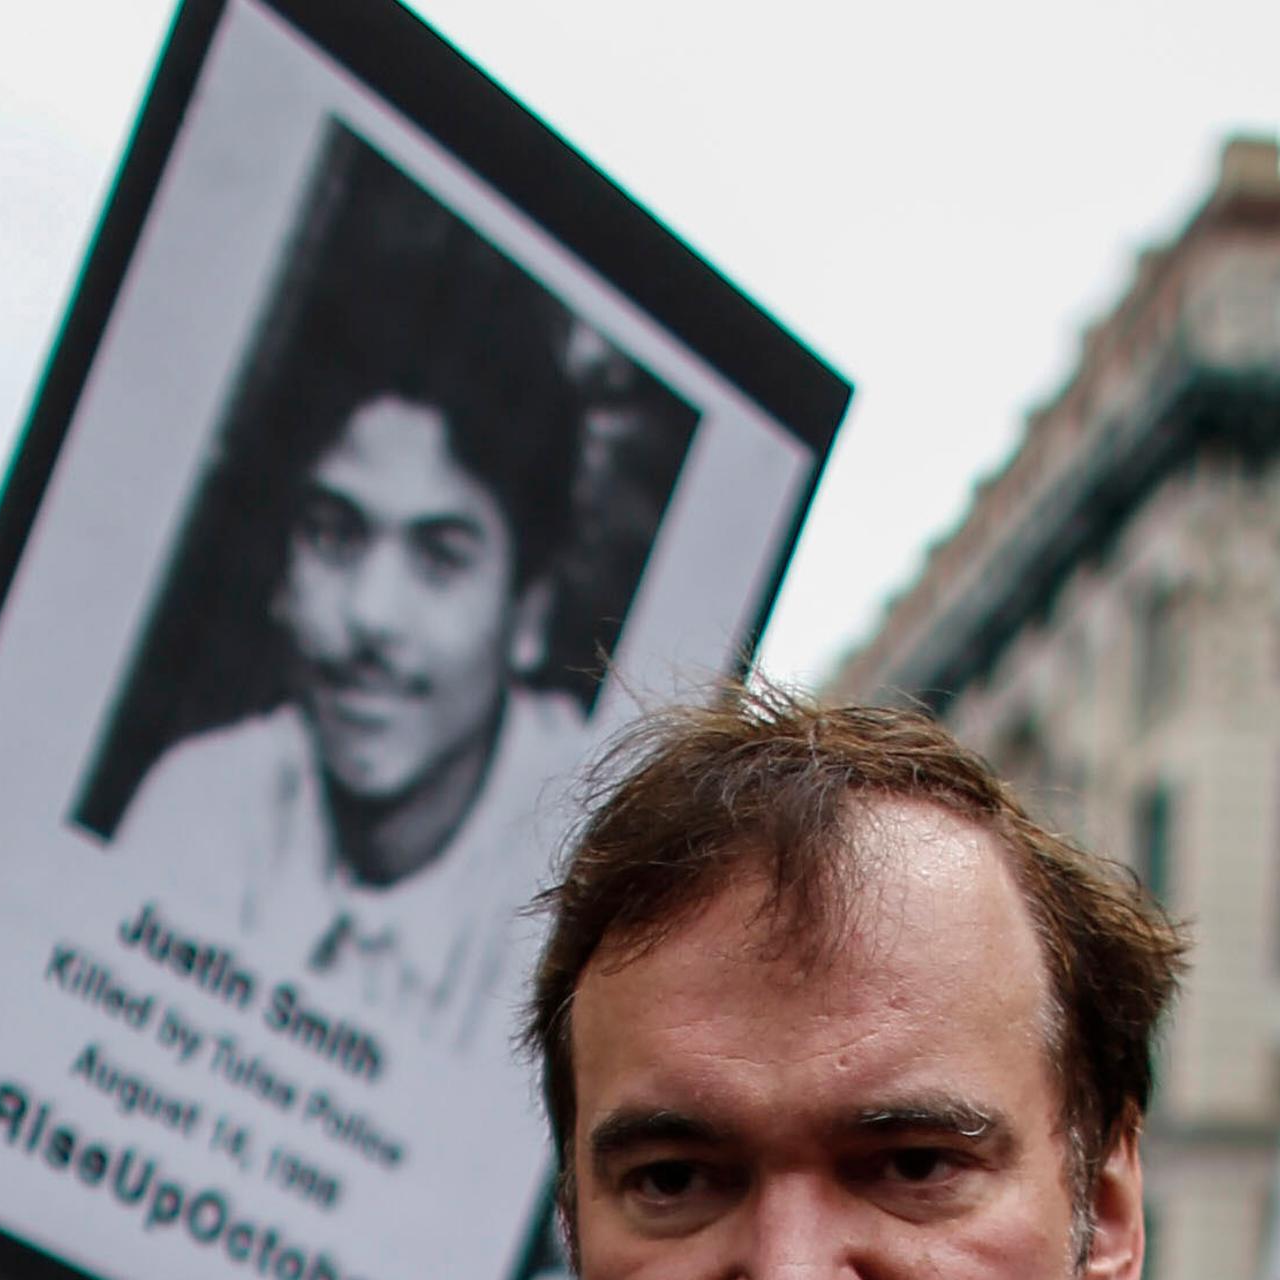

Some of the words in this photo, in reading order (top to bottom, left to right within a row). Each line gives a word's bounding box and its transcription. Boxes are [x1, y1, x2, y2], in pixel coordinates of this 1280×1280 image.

[44, 943, 154, 1030] Killed
[157, 1008, 203, 1063] by
[119, 902, 256, 1013] Justin
[264, 981, 386, 1083] Smith
[70, 1042, 200, 1137] August
